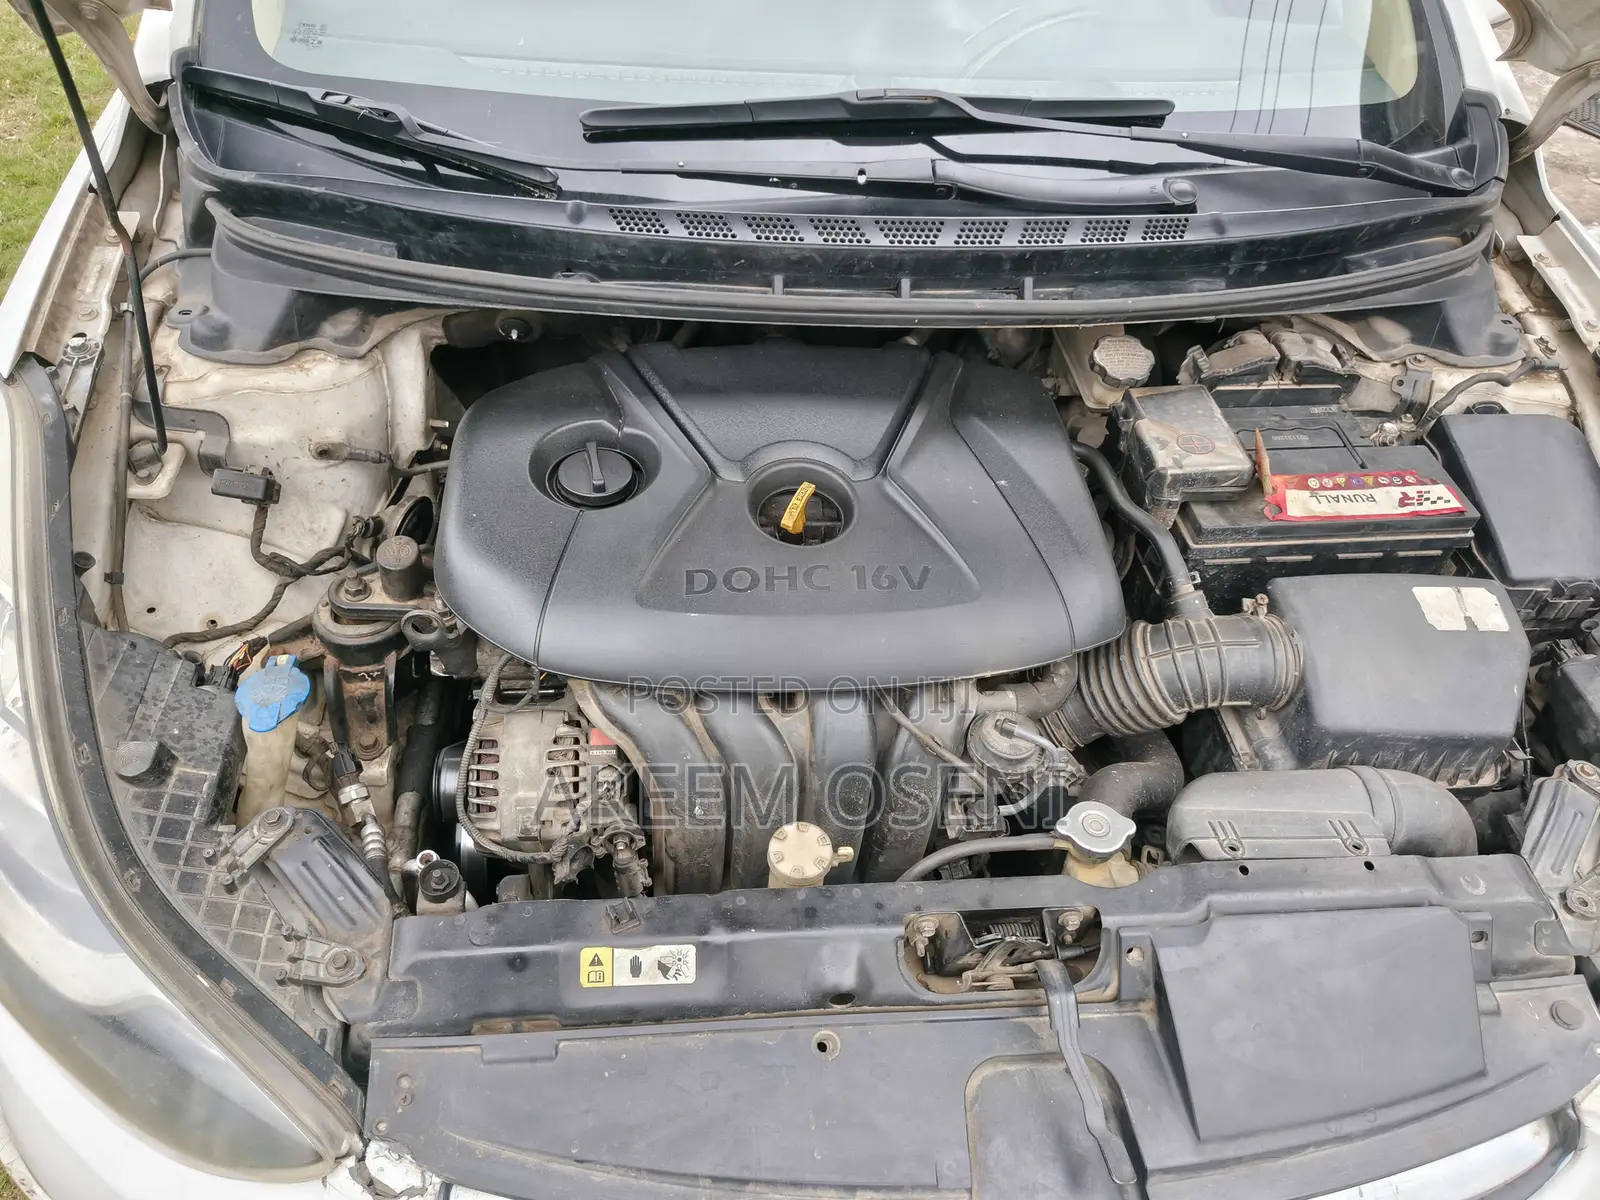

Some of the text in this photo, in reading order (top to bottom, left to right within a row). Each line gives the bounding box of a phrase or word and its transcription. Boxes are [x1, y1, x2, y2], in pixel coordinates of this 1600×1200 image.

[1309, 492, 1377, 505] RUNALL
[684, 564, 932, 597] DOHC 16V
